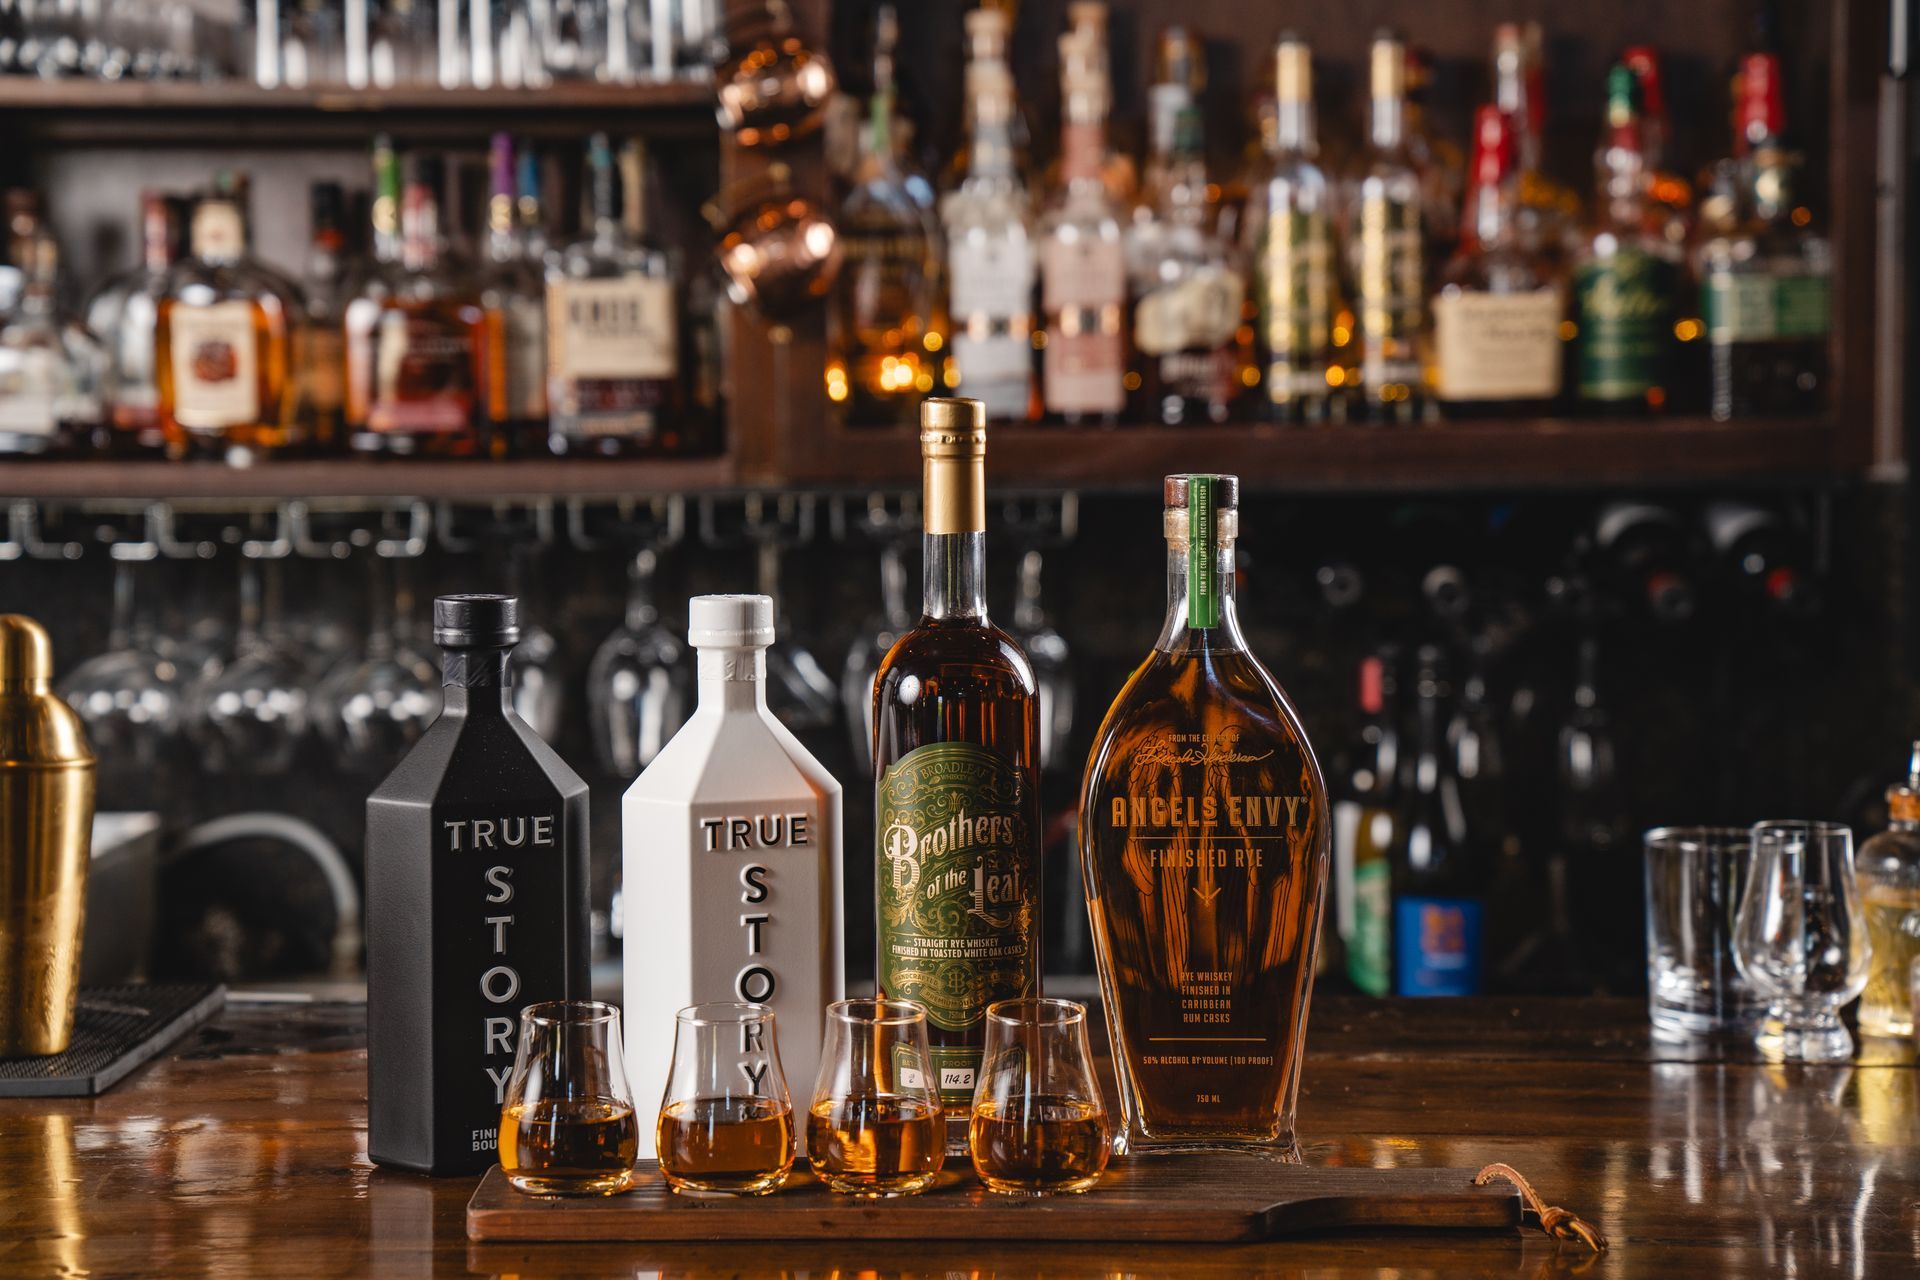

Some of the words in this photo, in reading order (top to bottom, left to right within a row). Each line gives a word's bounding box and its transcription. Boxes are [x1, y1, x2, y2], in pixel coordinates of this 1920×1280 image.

[1168, 733, 1187, 743] FROM
[1188, 733, 1201, 743] THE
[1231, 733, 1240, 743] OF
[1111, 796, 1218, 828] ANGELS
[445, 815, 553, 850] TRUE
[702, 814, 808, 850] TRUE
[884, 807, 1014, 891] Brothers
[1150, 848, 1232, 868] FINISHED
[1235, 848, 1263, 868] RYE
[926, 874, 941, 900] of
[945, 866, 968, 894] the
[967, 855, 1022, 922] Leaf
[913, 938, 949, 948] STRAIGHT
[950, 939, 965, 948] RYE
[966, 938, 998, 948] WHISKEY
[892, 945, 919, 957] FINISHED
[920, 948, 928, 957] IN
[929, 948, 962, 958] TOASTED
[963, 948, 987, 958] WHITE
[988, 948, 1002, 957] OAK
[1003, 945, 1022, 956] CASKS
[738, 864, 777, 1096] STORY
[1181, 972, 1194, 981] RYE
[1197, 972, 1233, 981] WHISKEY
[480, 865, 521, 1105] STORY
[1181, 986, 1219, 995] FINISHED
[1222, 986, 1231, 995] IN
[1181, 1000, 1231, 1009] CARIBBEAN
[1183, 1013, 1201, 1023] RUM
[1203, 1013, 1231, 1023] CASKS
[942, 1060, 971, 1068] PROOF
[1143, 1056, 1158, 1065] 50%
[1160, 1056, 1190, 1065] ALCOHOL
[1191, 1056, 1201, 1065] BY
[1202, 1056, 1228, 1065] VOLUME
[944, 1074, 971, 1085] 114.2
[1196, 1094, 1209, 1103] 750
[1211, 1094, 1221, 1103] ML
[472, 1128, 497, 1140] FINI
